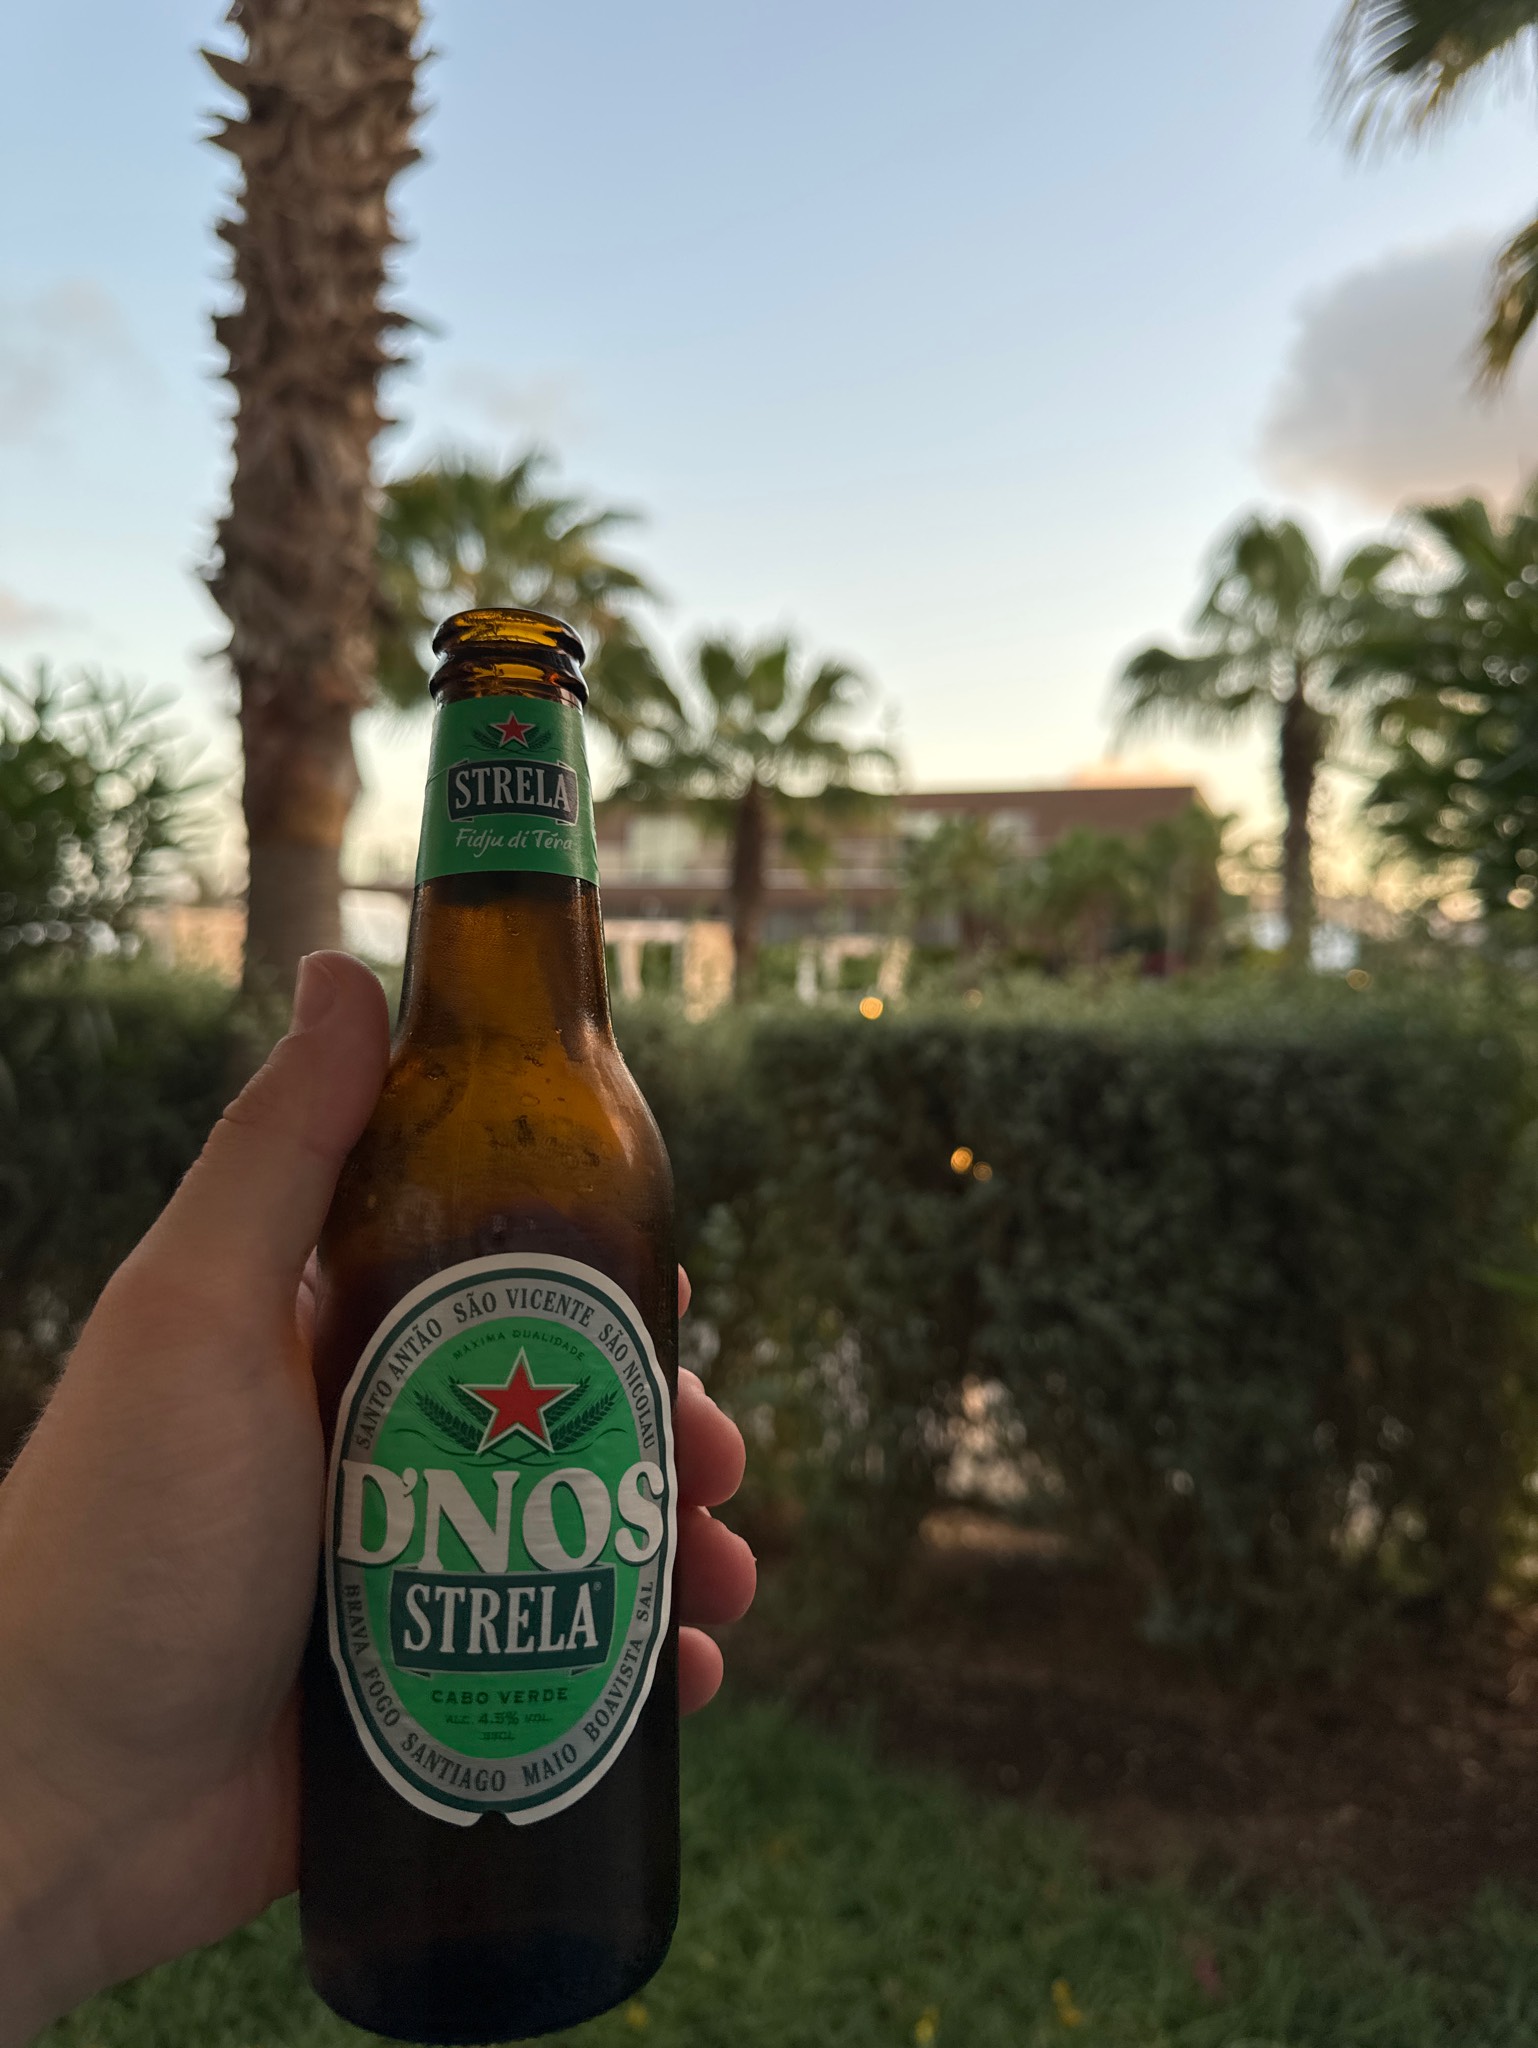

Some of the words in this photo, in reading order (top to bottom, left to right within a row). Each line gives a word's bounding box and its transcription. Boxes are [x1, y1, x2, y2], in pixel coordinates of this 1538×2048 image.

[455, 766, 572, 813] STRELA
[456, 828, 504, 858] Fidju
[508, 830, 530, 849] di
[453, 1292, 498, 1323] SÃO
[505, 1287, 595, 1328] VICENTE
[512, 1329, 586, 1362] QUALIDADE
[356, 1374, 393, 1450] SANTO
[388, 1316, 443, 1381] ANTÃO
[598, 1323, 625, 1364] SÃO
[621, 1361, 656, 1450] NICOLAU
[344, 1584, 371, 1656] BRAVA
[362, 1666, 400, 1727] FOGO
[401, 1732, 507, 1793] SANTIAGO
[522, 1743, 578, 1788] MAIO
[582, 1638, 643, 1742] BOAVISTA
[636, 1581, 654, 1623] SAL
[431, 1689, 489, 1705] CABO
[498, 1687, 569, 1704] VERDE
